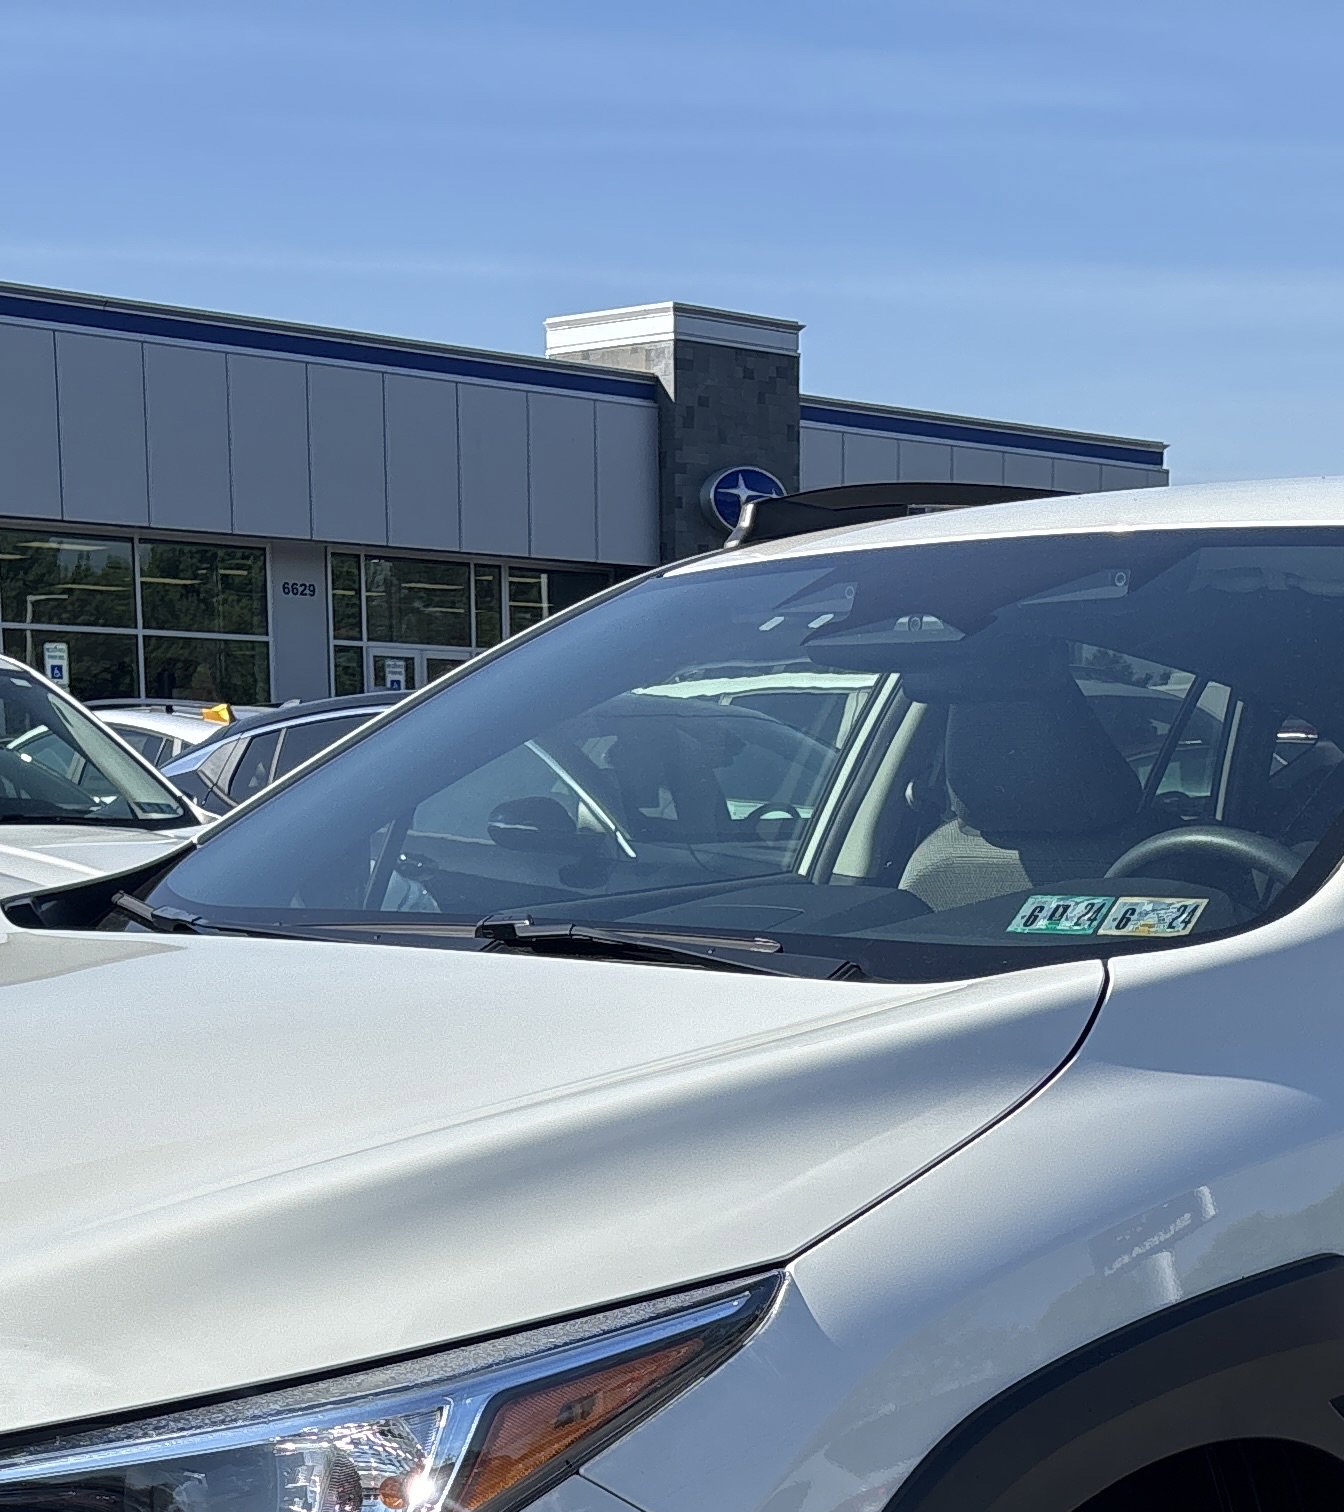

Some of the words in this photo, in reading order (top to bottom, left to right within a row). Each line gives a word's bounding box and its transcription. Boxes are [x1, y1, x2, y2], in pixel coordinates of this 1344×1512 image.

[282, 582, 316, 597] 6629
[1023, 905, 1045, 928] 6
[1074, 902, 1106, 928] 24
[1115, 907, 1137, 931] 6
[1166, 904, 1200, 931] 24
